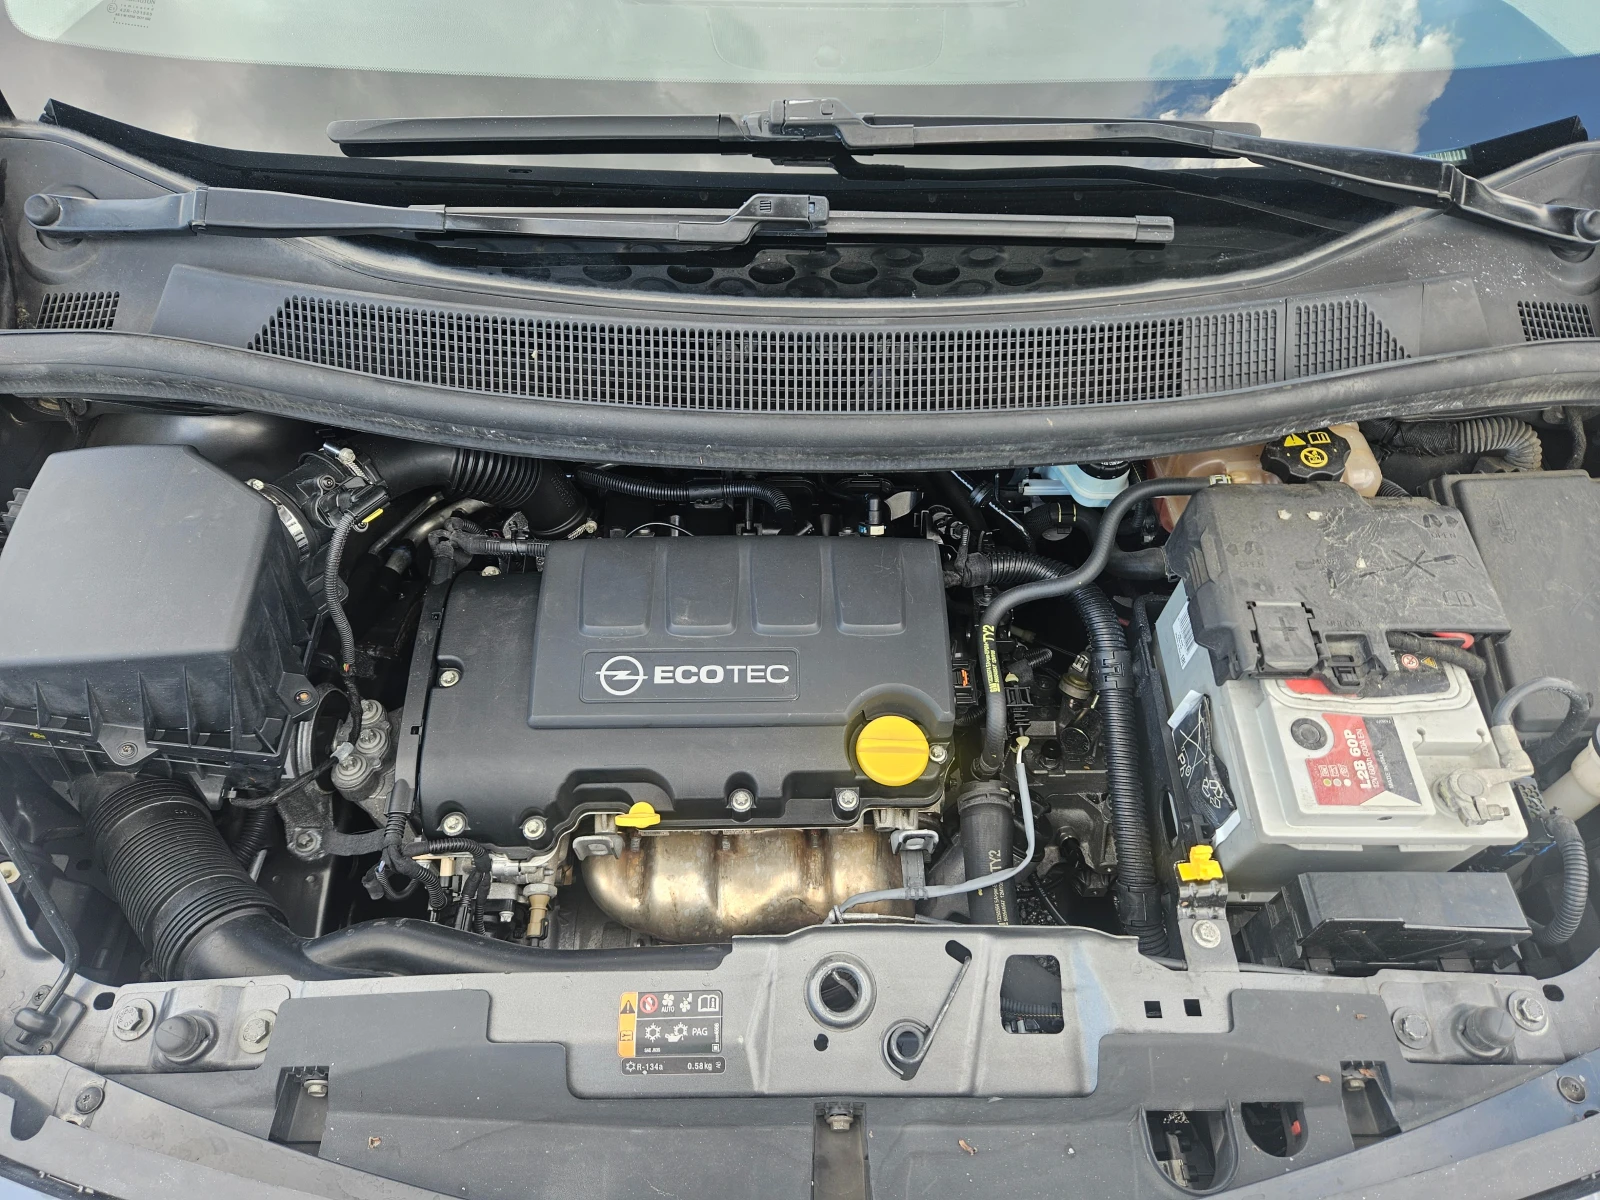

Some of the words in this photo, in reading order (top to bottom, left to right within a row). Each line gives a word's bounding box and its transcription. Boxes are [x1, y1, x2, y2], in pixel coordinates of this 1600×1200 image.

[982, 624, 995, 641] TY2
[653, 664, 790, 684] ECOTEC
[1343, 728, 1361, 757] 60P
[1360, 739, 1371, 757] 600A
[1353, 759, 1372, 789] L2B
[988, 849, 1002, 872] TY2
[692, 1027, 708, 1036] PAG
[636, 1063, 663, 1071] R-134a
